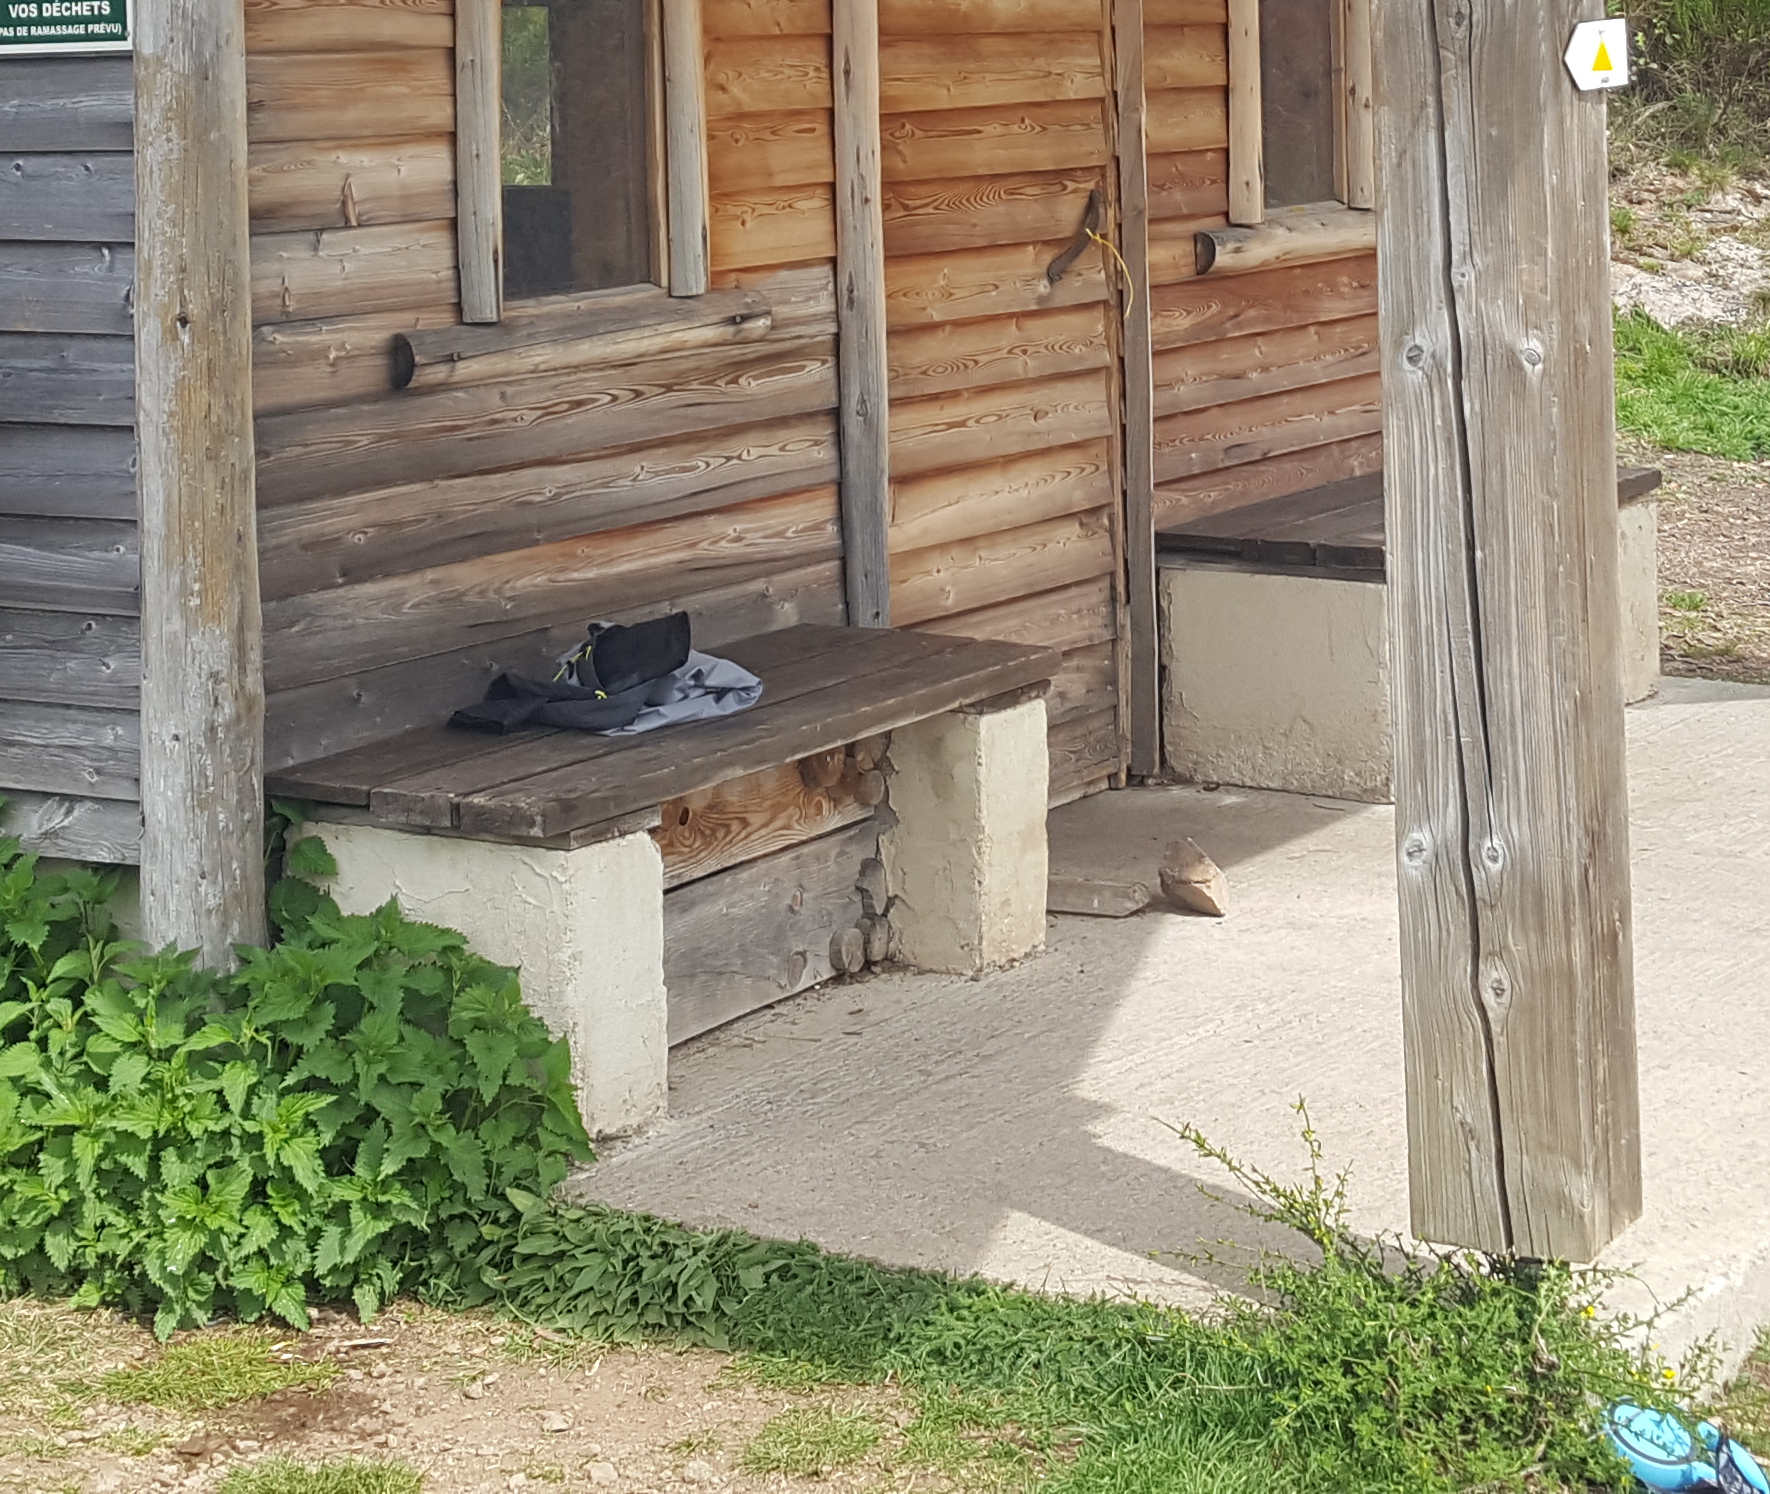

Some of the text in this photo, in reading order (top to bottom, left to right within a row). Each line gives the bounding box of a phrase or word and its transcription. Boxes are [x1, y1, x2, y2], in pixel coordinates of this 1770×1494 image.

[8, 3, 39, 19] VOS
[16, 25, 29, 36] DE
[30, 23, 86, 36] RAMASSAGE
[87, 21, 122, 36] PRÉVU)
